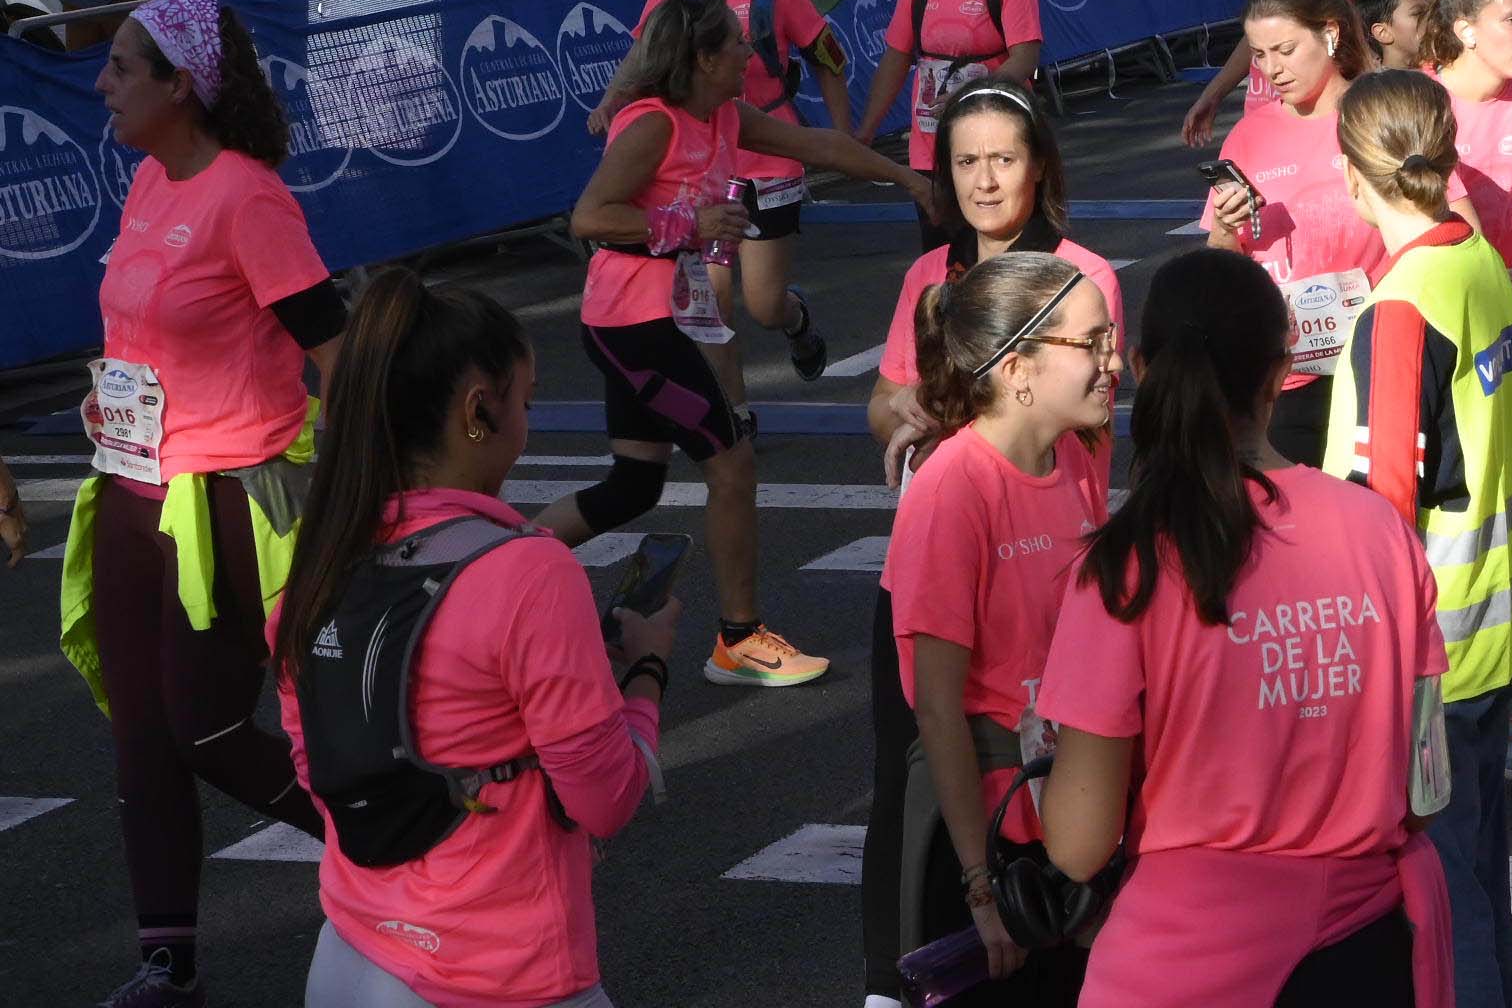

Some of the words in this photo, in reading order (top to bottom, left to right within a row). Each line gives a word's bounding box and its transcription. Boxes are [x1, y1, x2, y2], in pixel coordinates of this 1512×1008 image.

[471, 66, 563, 114] ASTURIANA
[1256, 164, 1298, 183] OYSHO
[1302, 315, 1337, 336] 016
[1309, 336, 1337, 348] 17366
[103, 406, 136, 425] 016
[1227, 592, 1381, 645] CARRERA
[1260, 637, 1305, 675] DE
[1316, 629, 1356, 665] LA
[1258, 664, 1362, 710] MUJER
[1299, 705, 1328, 719] 2023
